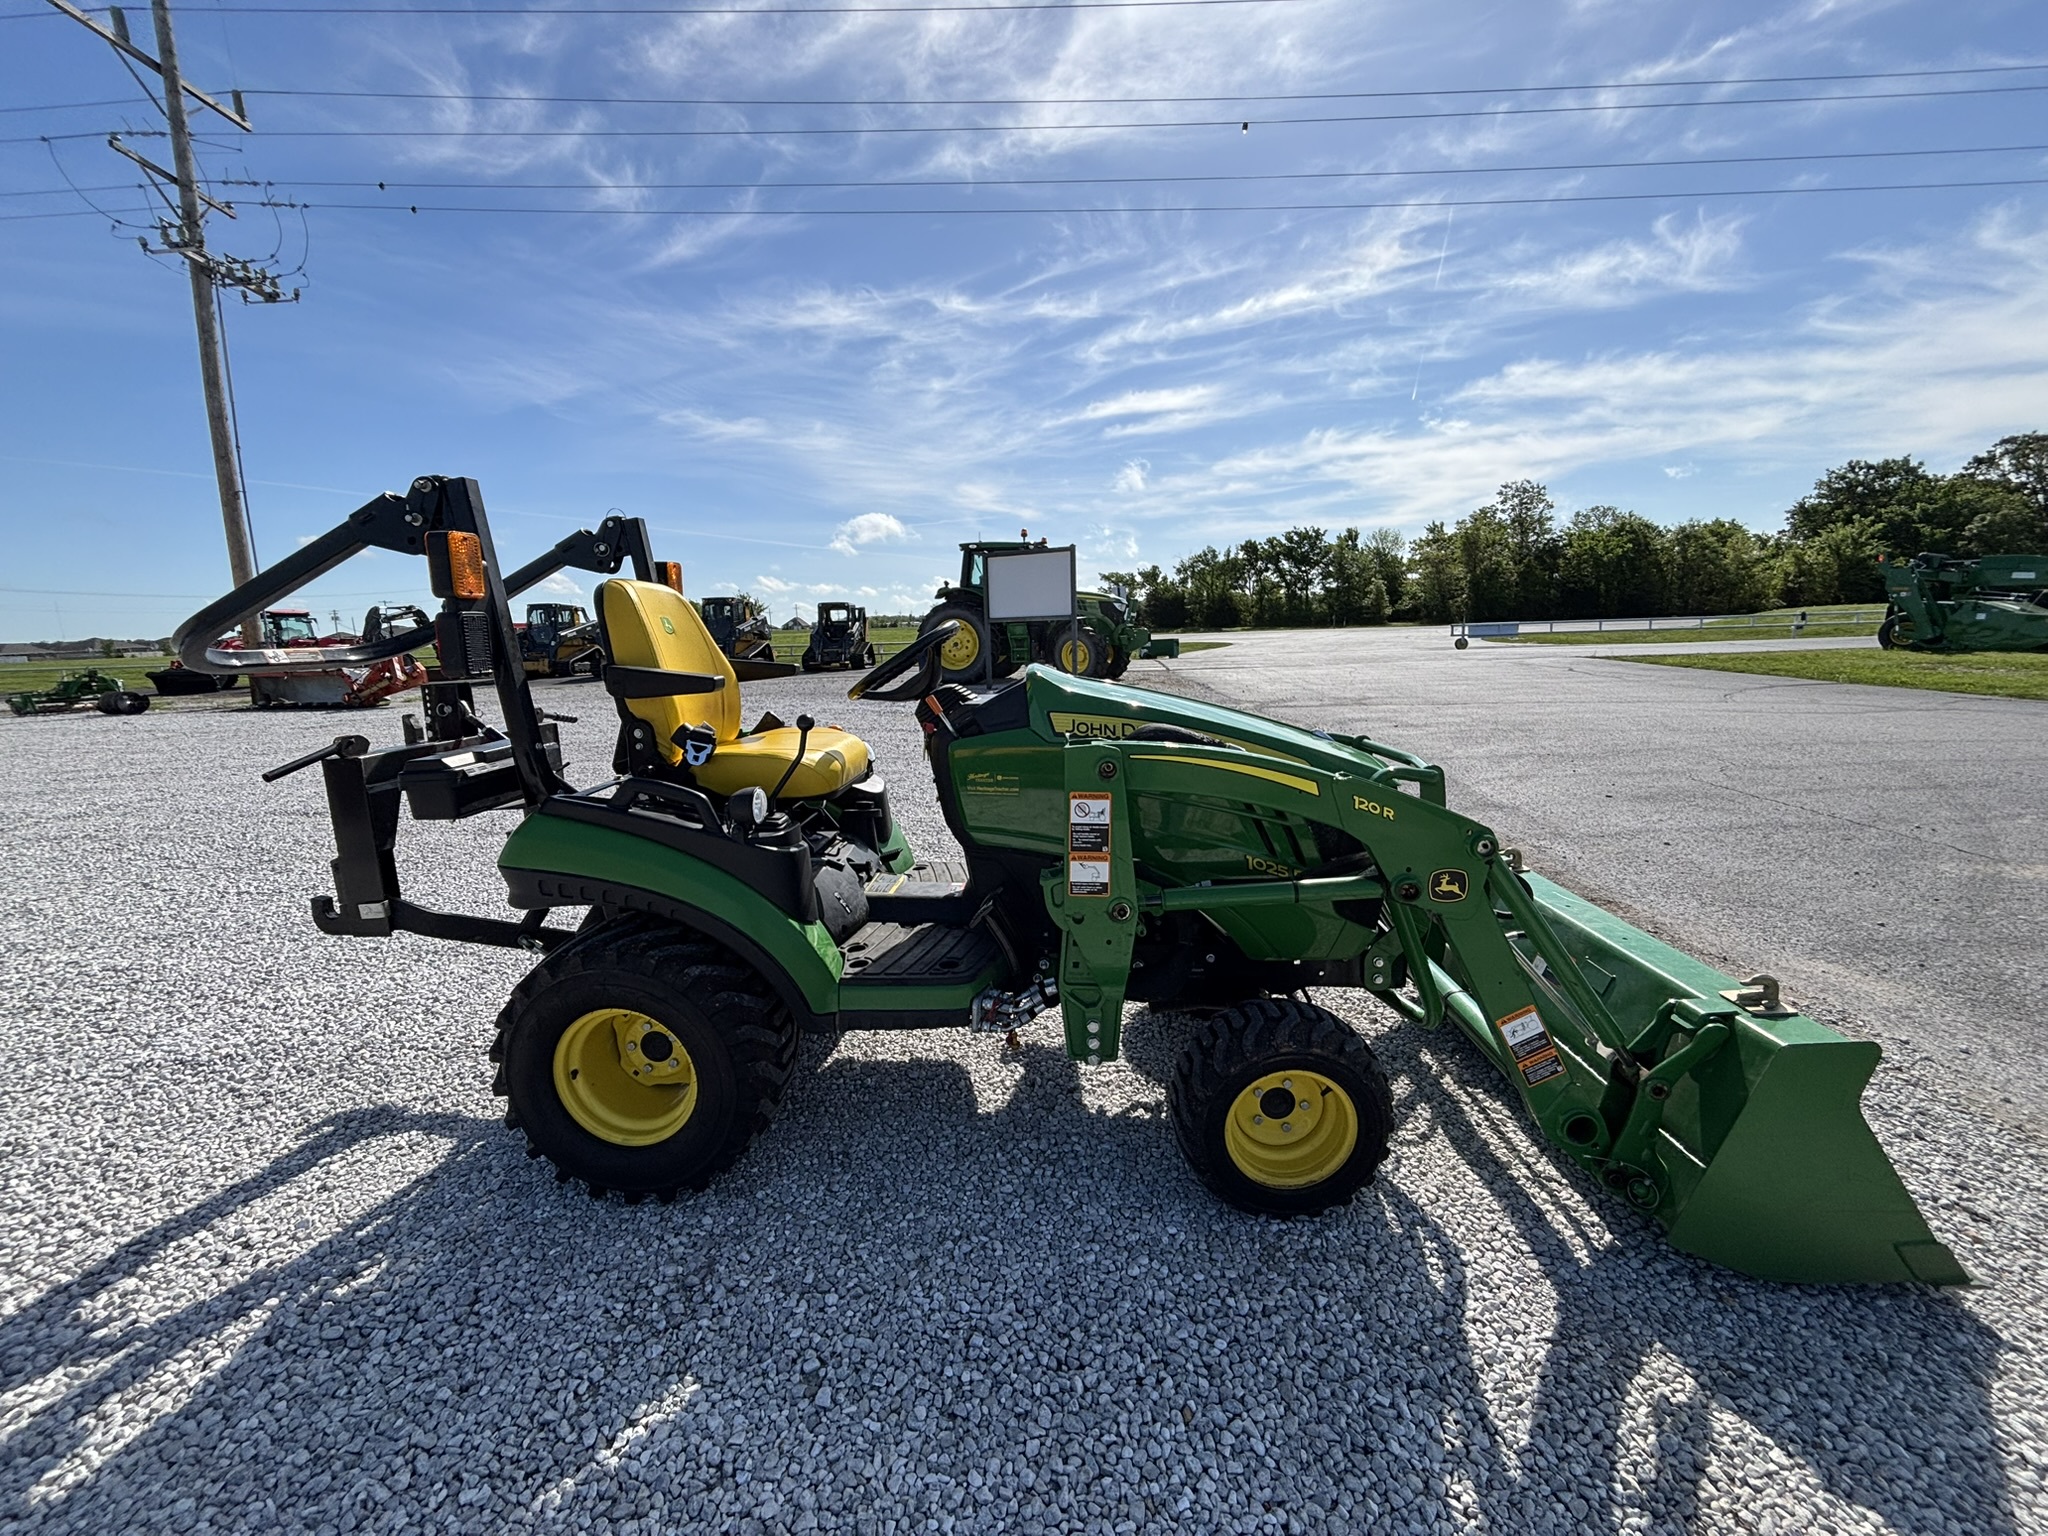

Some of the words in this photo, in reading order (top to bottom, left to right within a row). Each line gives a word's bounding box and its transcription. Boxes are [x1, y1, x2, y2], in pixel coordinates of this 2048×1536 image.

[1066, 719, 1116, 737] JOHN
[1507, 1007, 1532, 1021] WARNING
[1529, 1051, 1554, 1065] WARNING
